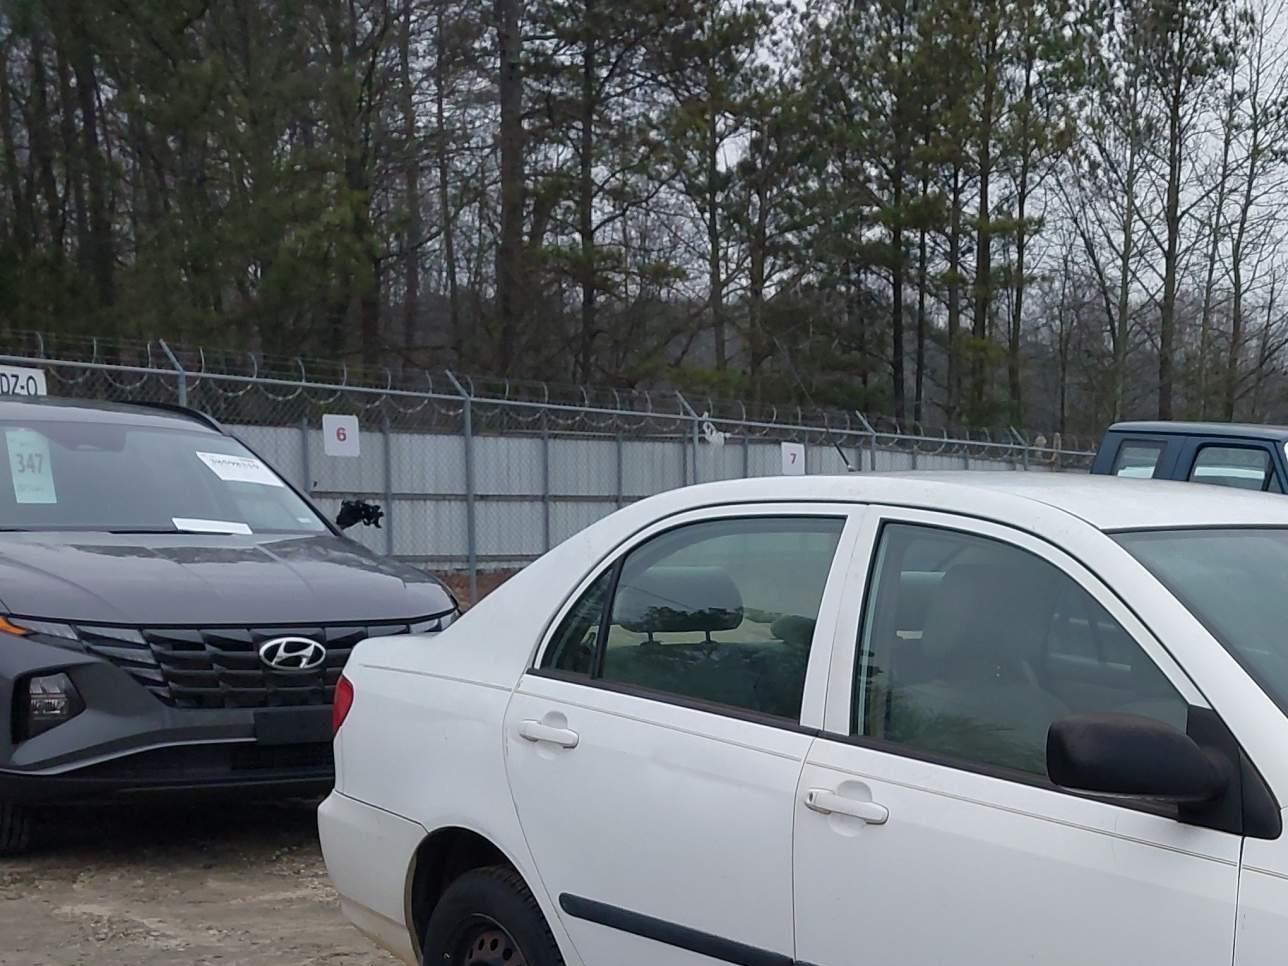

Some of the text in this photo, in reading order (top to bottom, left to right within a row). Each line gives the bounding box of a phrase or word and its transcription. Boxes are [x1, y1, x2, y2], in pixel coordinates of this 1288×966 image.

[336, 427, 347, 442] 6
[16, 453, 43, 474] 347
[790, 453, 797, 464] 7
